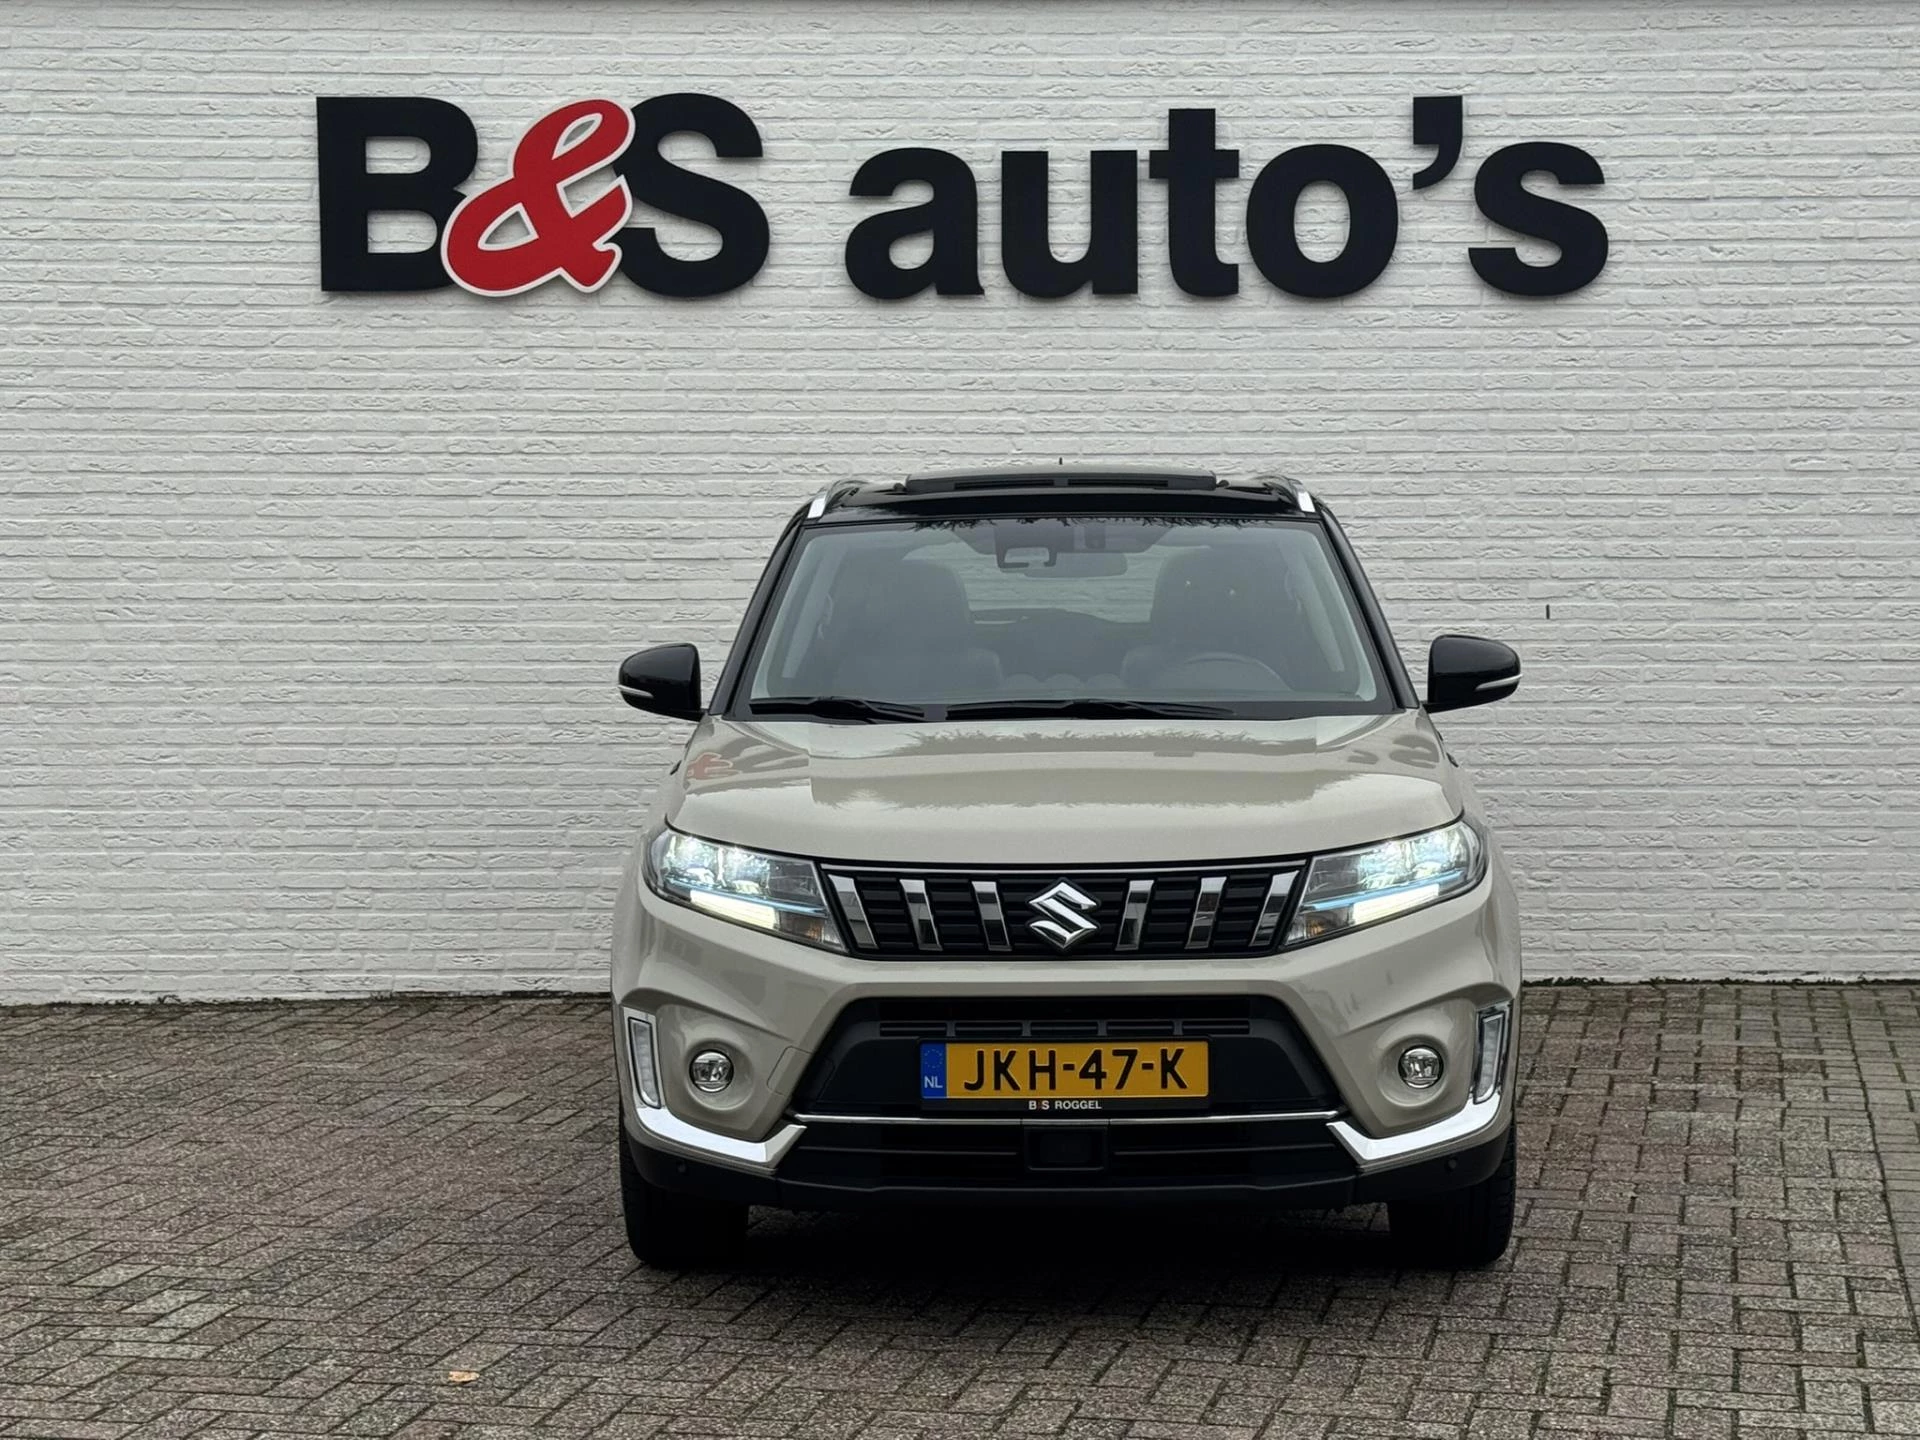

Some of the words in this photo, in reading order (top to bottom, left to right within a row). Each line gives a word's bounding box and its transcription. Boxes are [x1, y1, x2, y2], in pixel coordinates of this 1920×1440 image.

[316, 93, 770, 297] B&S
[844, 95, 1610, 299] auto's
[924, 1076, 942, 1088] NL
[964, 1048, 1187, 1091] JKH-47-K
[1055, 1100, 1102, 1110] ROGGEL
